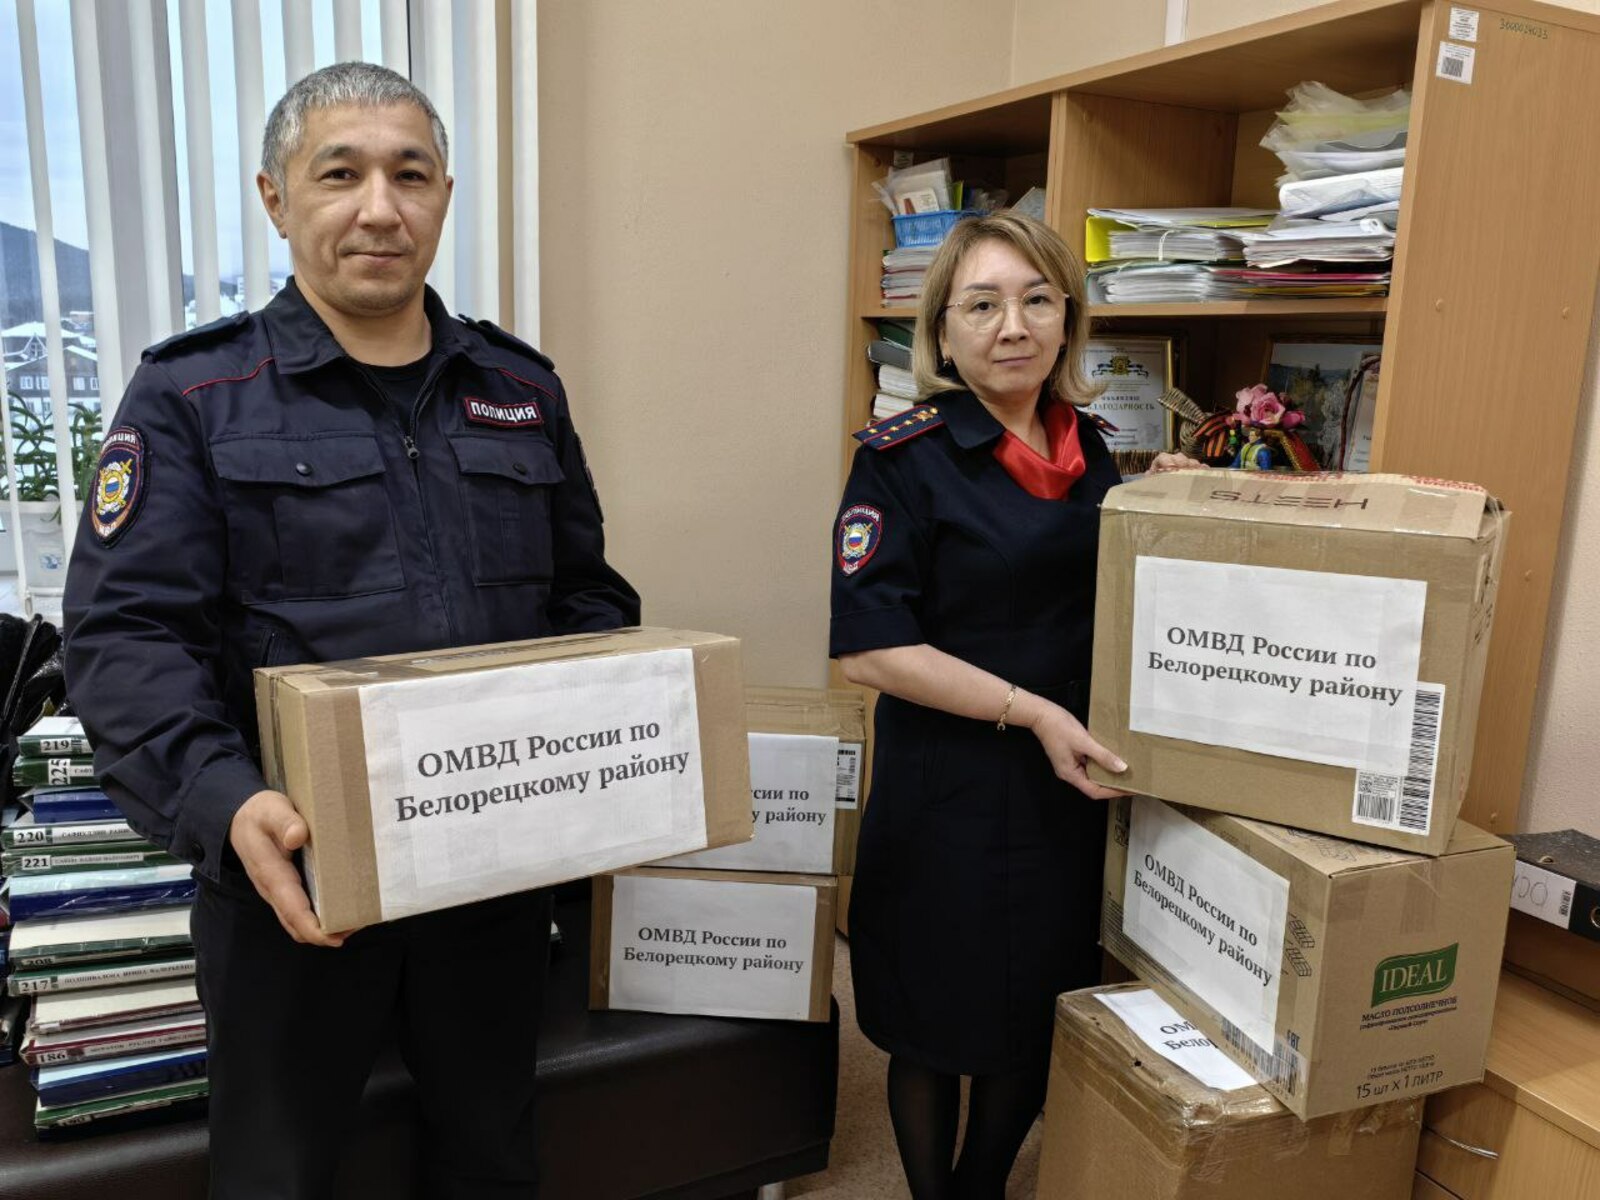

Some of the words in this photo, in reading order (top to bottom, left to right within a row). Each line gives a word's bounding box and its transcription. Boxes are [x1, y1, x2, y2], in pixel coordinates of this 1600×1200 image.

[470, 401, 538, 422] ПОЛИЦИЯ
[1167, 626, 1245, 656] ОМВД
[1252, 635, 1337, 665] России
[1345, 652, 1377, 670] по
[1147, 652, 1302, 693] Белорецкому
[1309, 677, 1404, 706] району
[43, 740, 70, 751] 219
[417, 739, 520, 778] ОМВД
[526, 728, 622, 760] России
[629, 721, 661, 742] по
[50, 759, 69, 785] 225
[395, 769, 591, 822] Белорецкому
[598, 752, 690, 789] району
[752, 789, 784, 801] сии
[788, 789, 810, 801] по
[765, 809, 827, 826] району
[17, 831, 44, 843] 220
[24, 858, 48, 868] 221
[1144, 854, 1184, 898] ОМВД
[1188, 886, 1236, 932] России
[1238, 923, 1258, 947] по
[638, 926, 697, 945] ОМВД
[701, 930, 761, 948] России
[766, 937, 787, 949] по
[1133, 869, 1217, 945] Белорецкому
[1217, 938, 1273, 987] району
[623, 946, 738, 969] Белорецкому
[742, 954, 804, 973] району
[21, 980, 49, 992] 217
[1379, 959, 1448, 993] IDEAL
[1159, 1020, 1198, 1035] ОМ
[39, 1050, 66, 1062] 186
[1356, 1082, 1372, 1100] 15
[1404, 1074, 1410, 1087] 1
